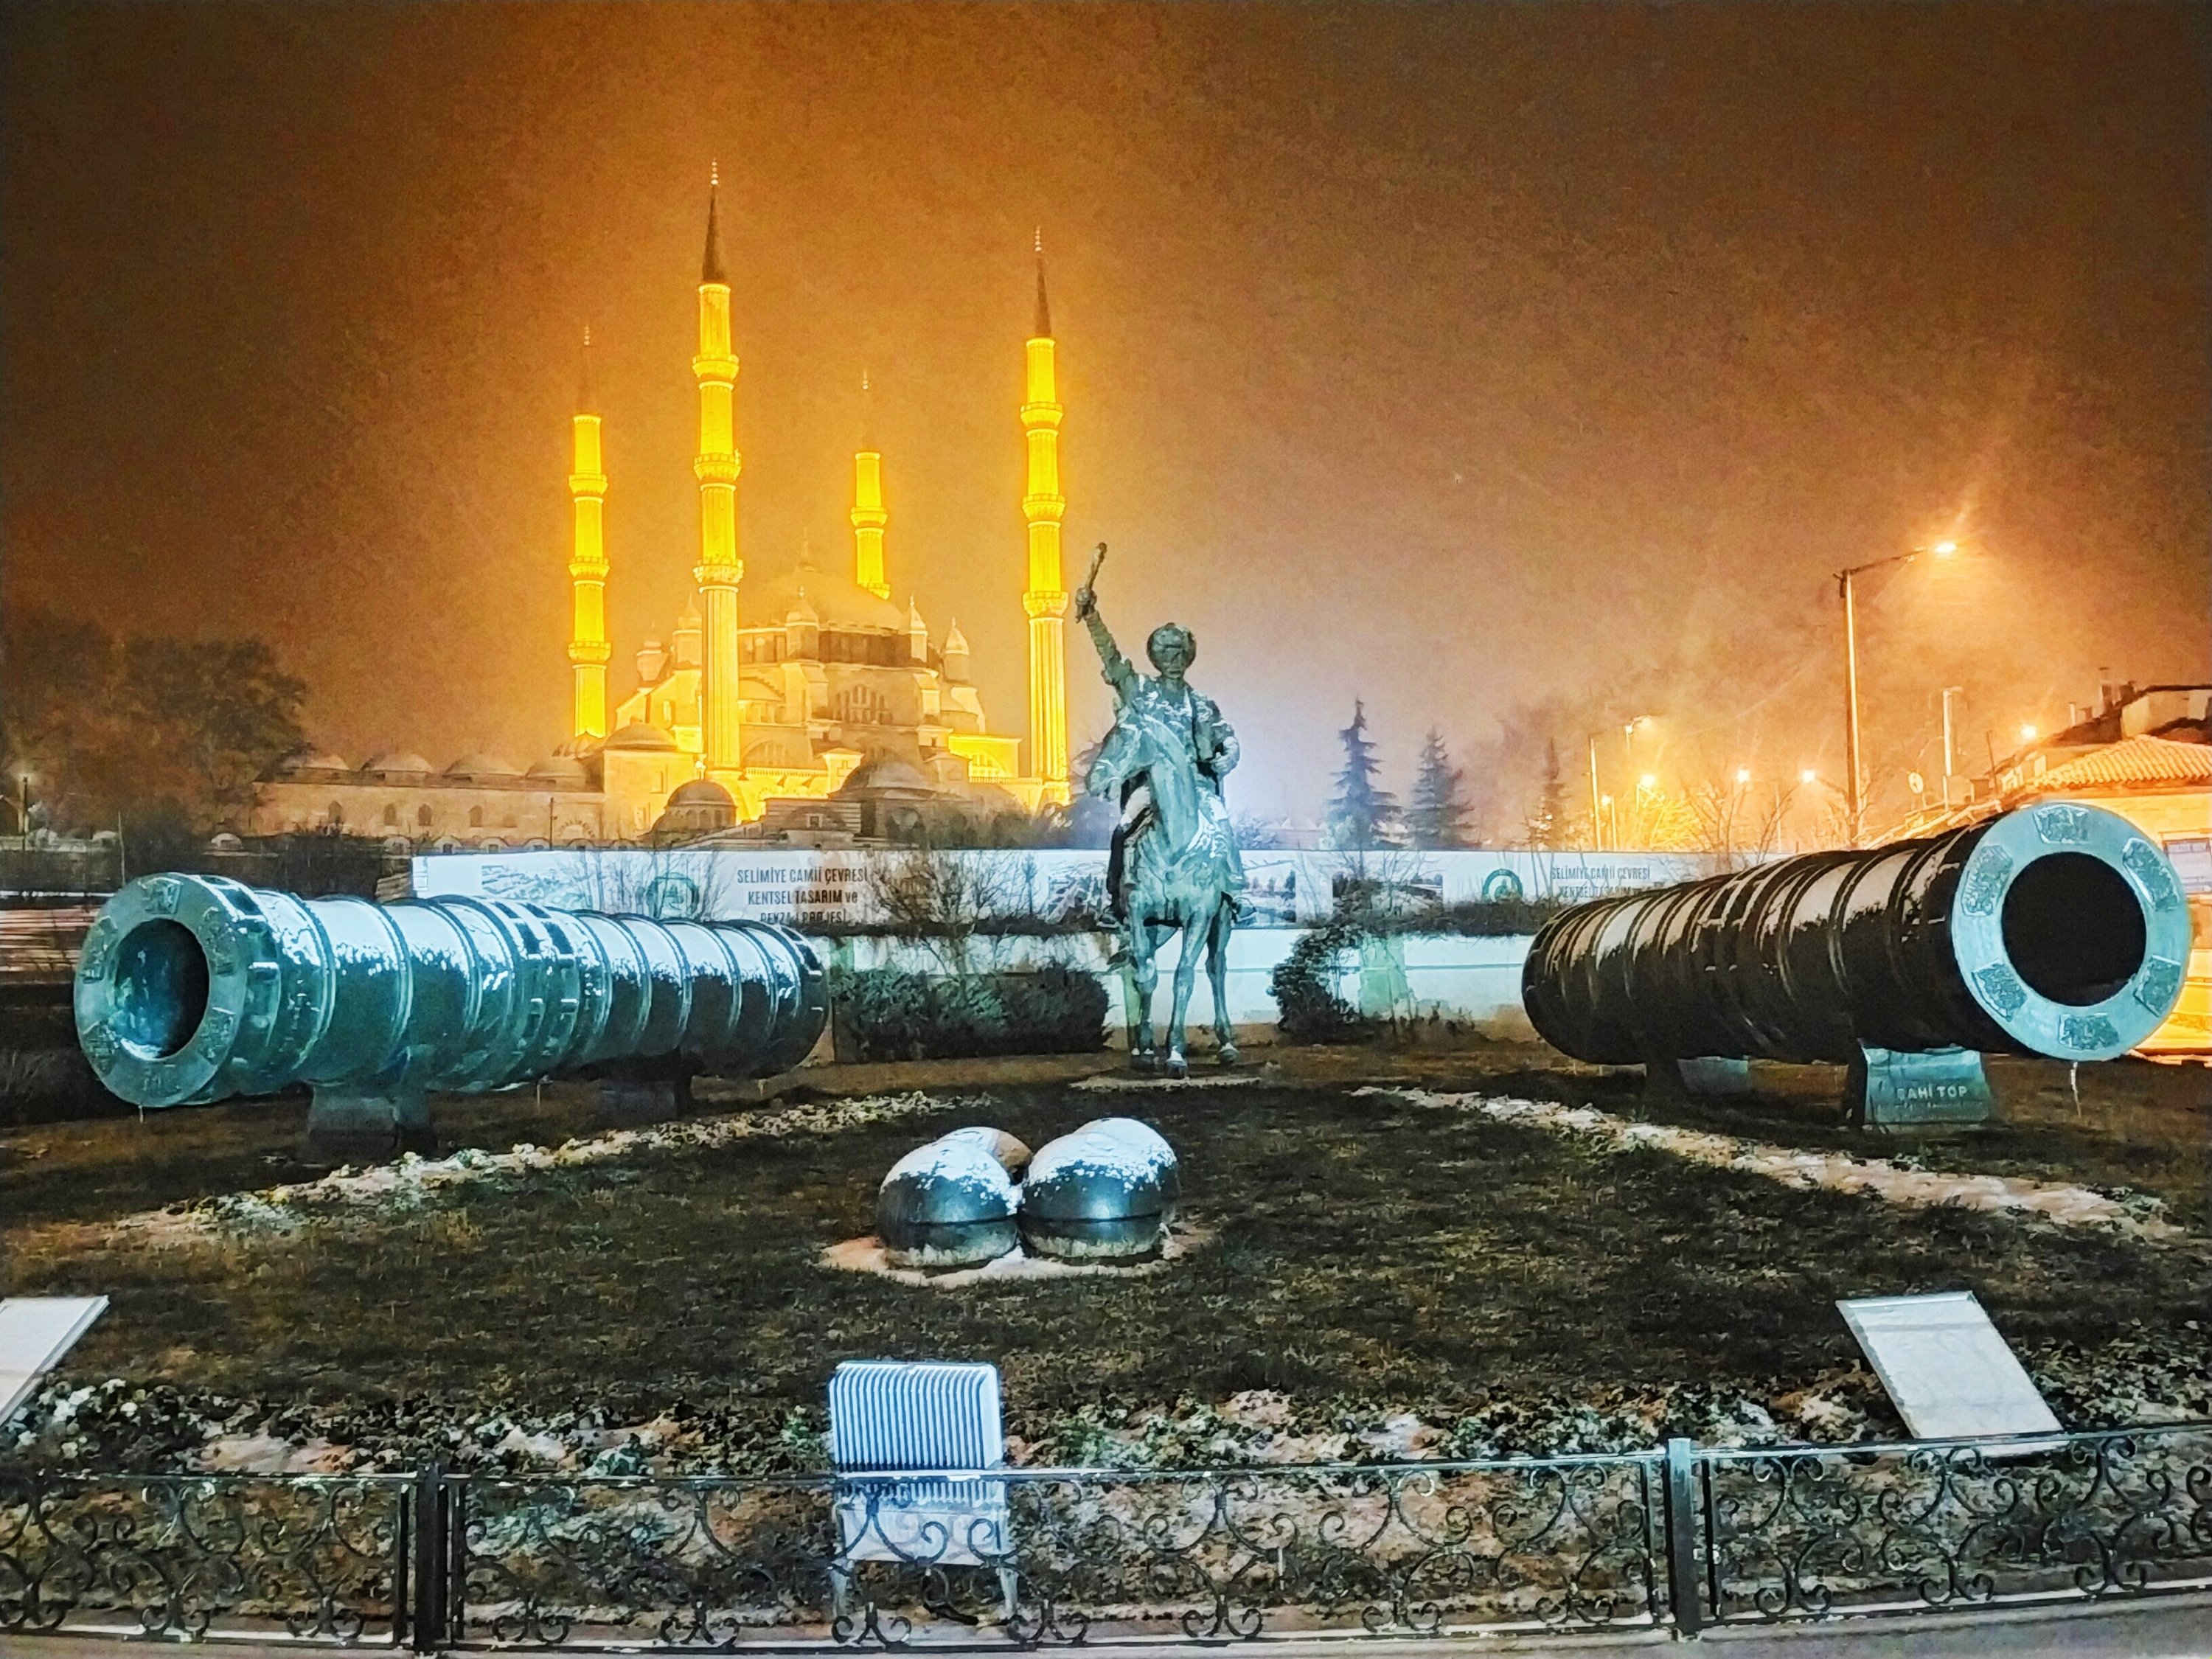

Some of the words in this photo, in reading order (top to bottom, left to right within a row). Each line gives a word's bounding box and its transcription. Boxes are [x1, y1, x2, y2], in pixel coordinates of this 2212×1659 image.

[737, 866, 787, 883] SELİMİYE
[790, 866, 822, 883] CAMİİ
[824, 866, 868, 886] ÇEVRESİ
[748, 891, 793, 905] KENTSEL
[795, 890, 842, 904] TASARIM
[845, 891, 858, 904] ve
[1936, 1085, 1968, 1098] TOP
